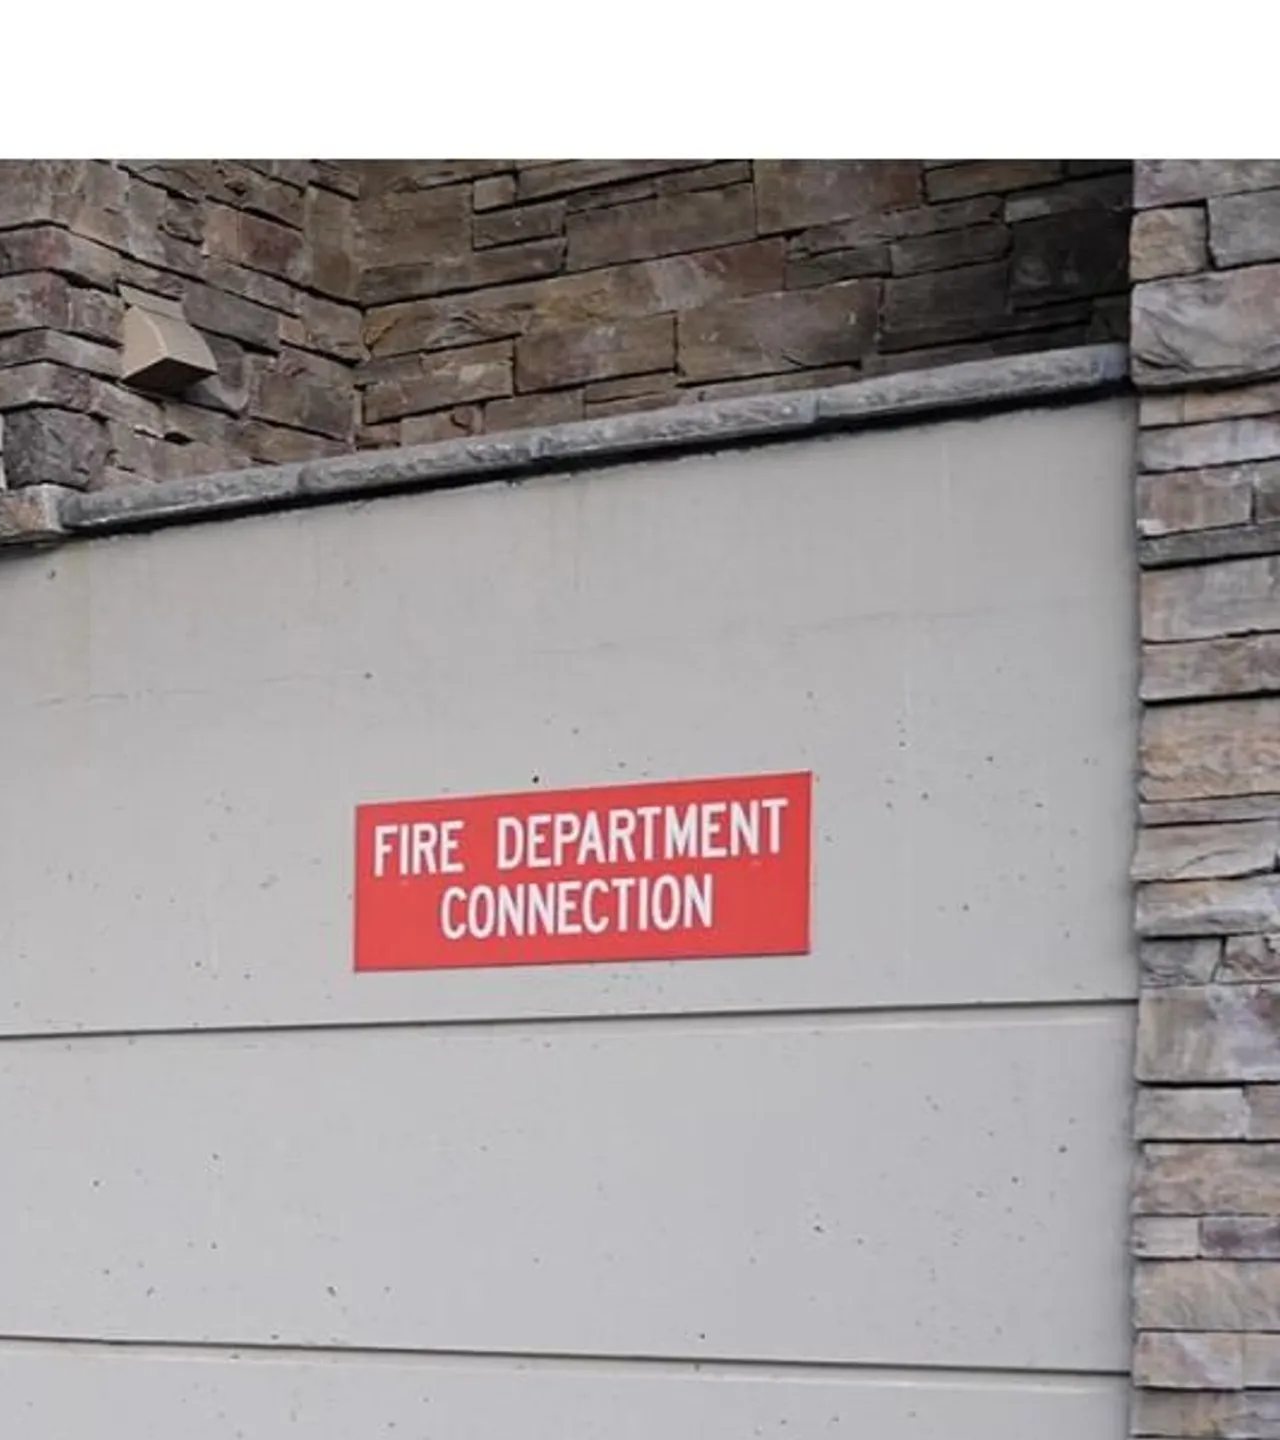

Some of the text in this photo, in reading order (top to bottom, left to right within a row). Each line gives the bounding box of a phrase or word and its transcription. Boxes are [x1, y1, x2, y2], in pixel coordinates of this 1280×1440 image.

[374, 797, 789, 877] FIRE DEPARTMENT
[441, 873, 713, 940] CONNECTION
